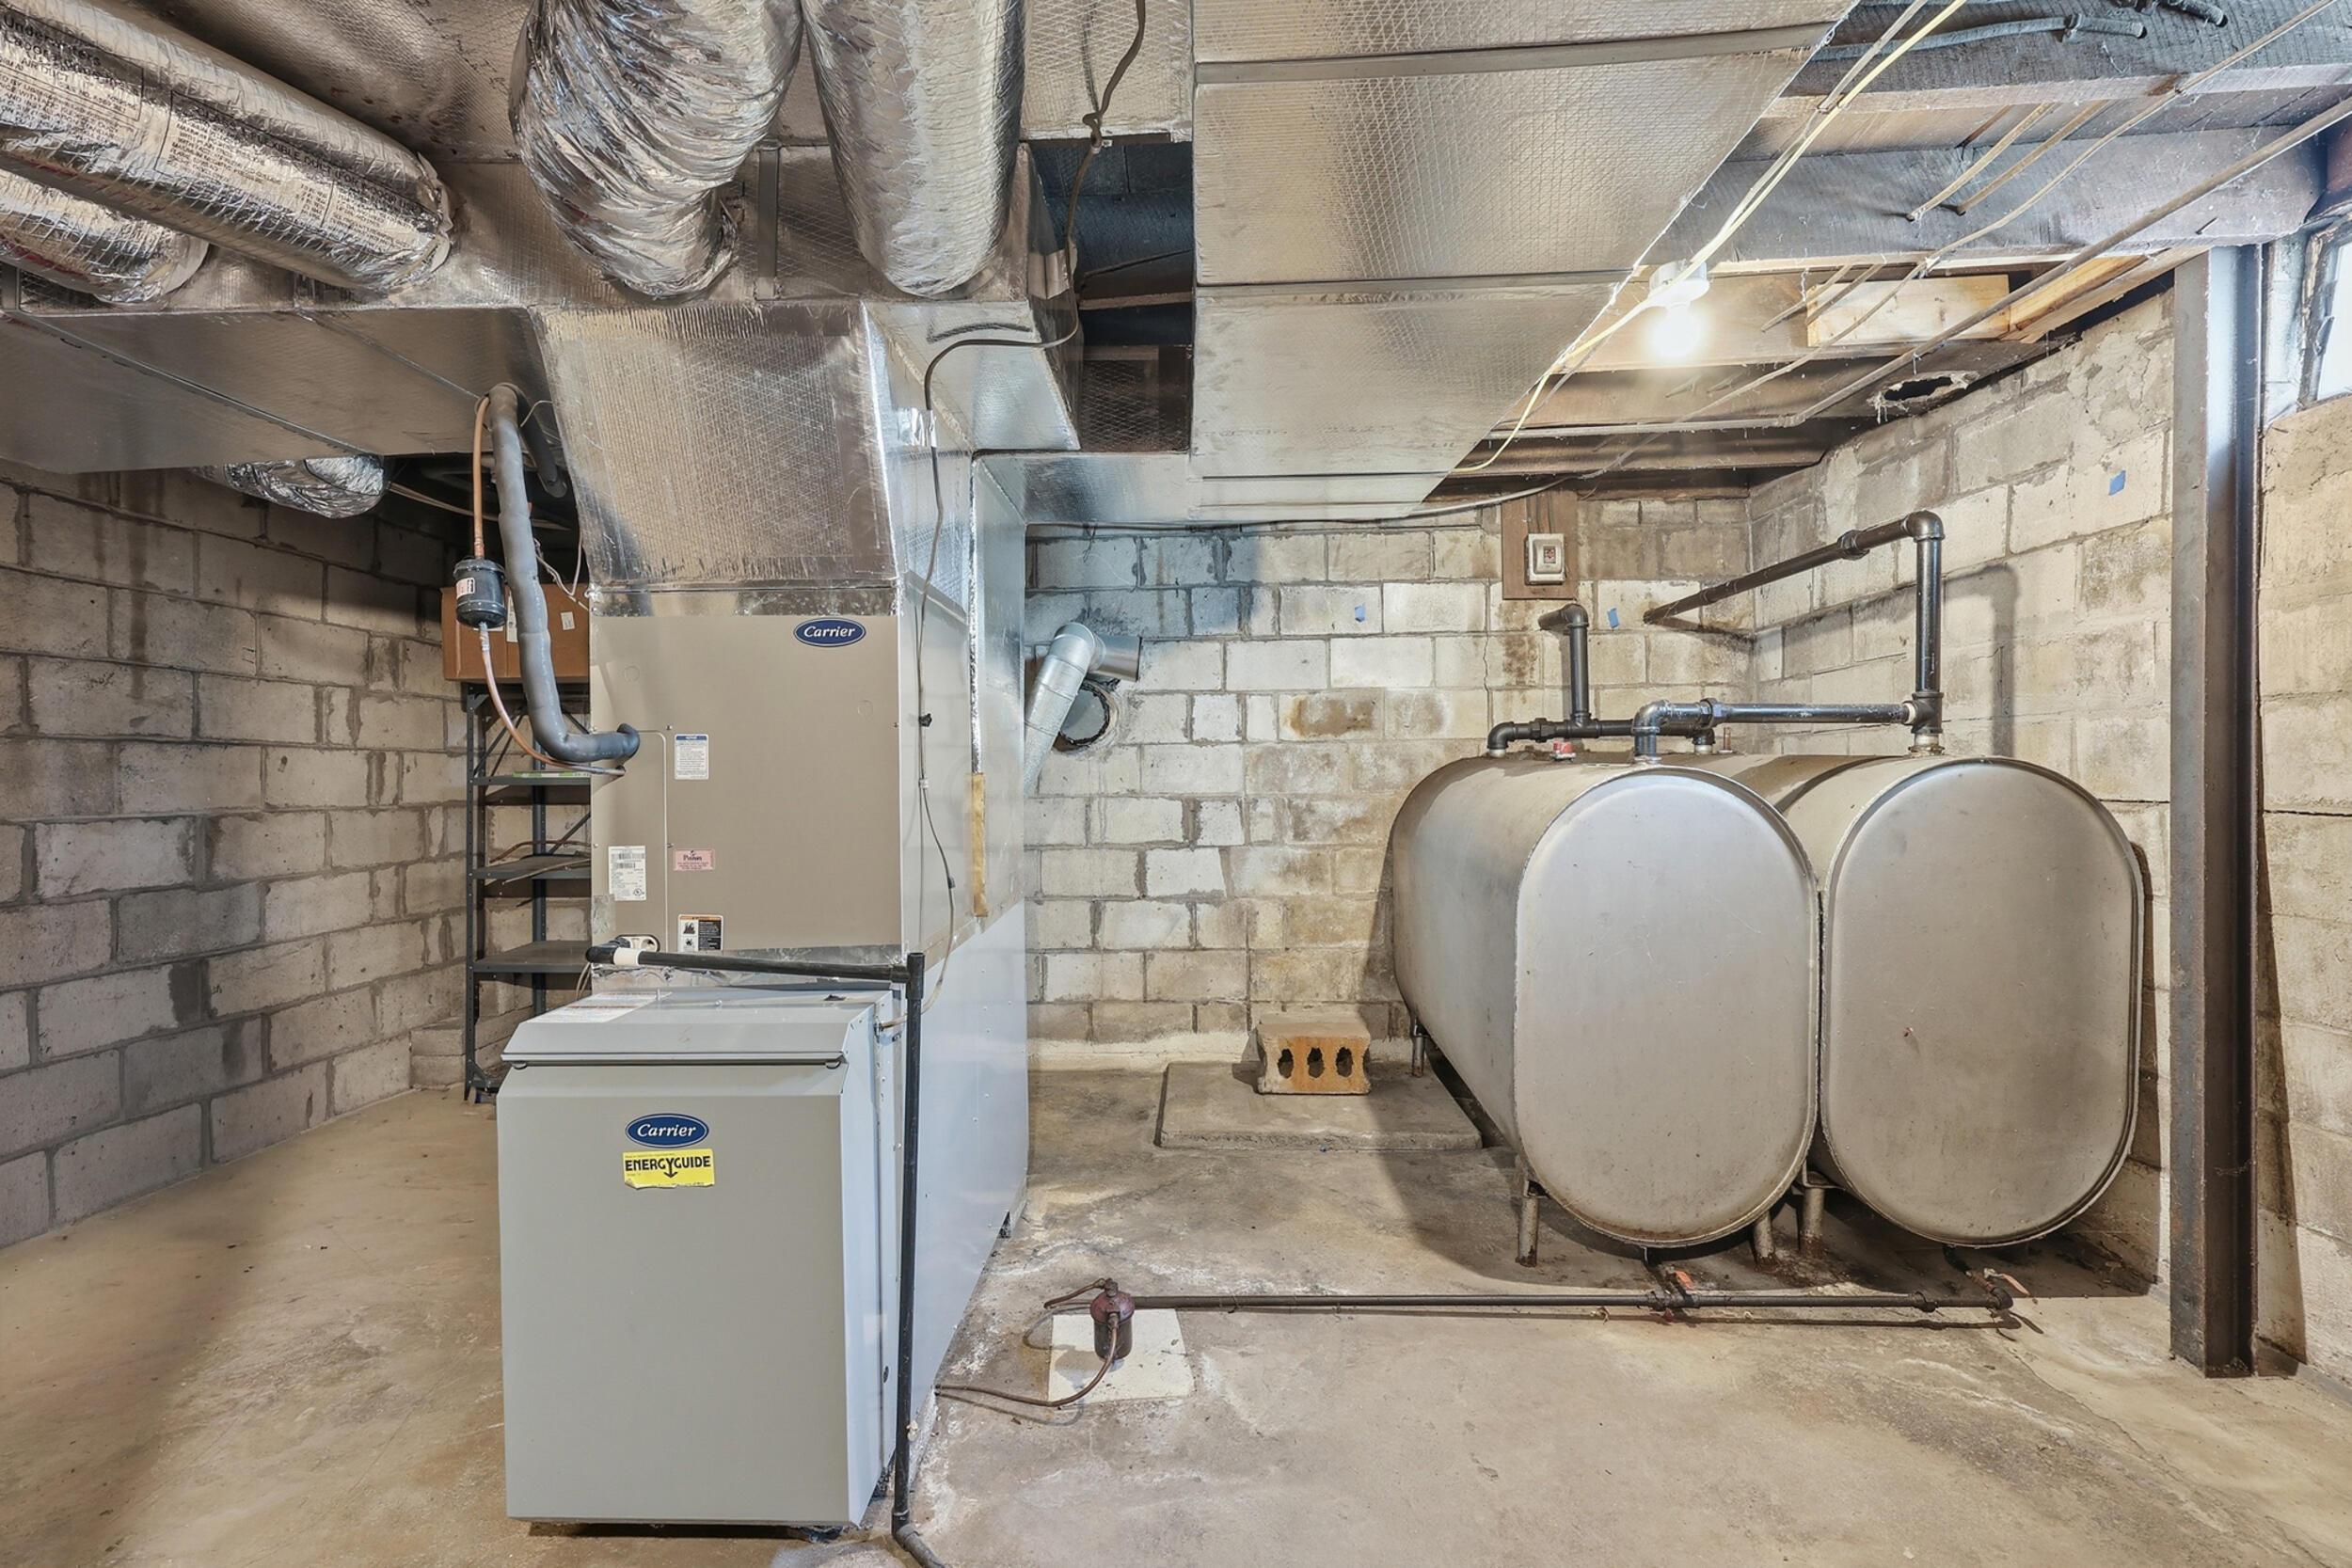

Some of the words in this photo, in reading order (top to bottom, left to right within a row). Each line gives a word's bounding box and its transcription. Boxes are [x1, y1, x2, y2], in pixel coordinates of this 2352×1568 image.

[803, 626, 856, 638] Carrier
[637, 1123, 696, 1137] Carrier
[625, 1156, 710, 1173] ENERGYGUIDE
